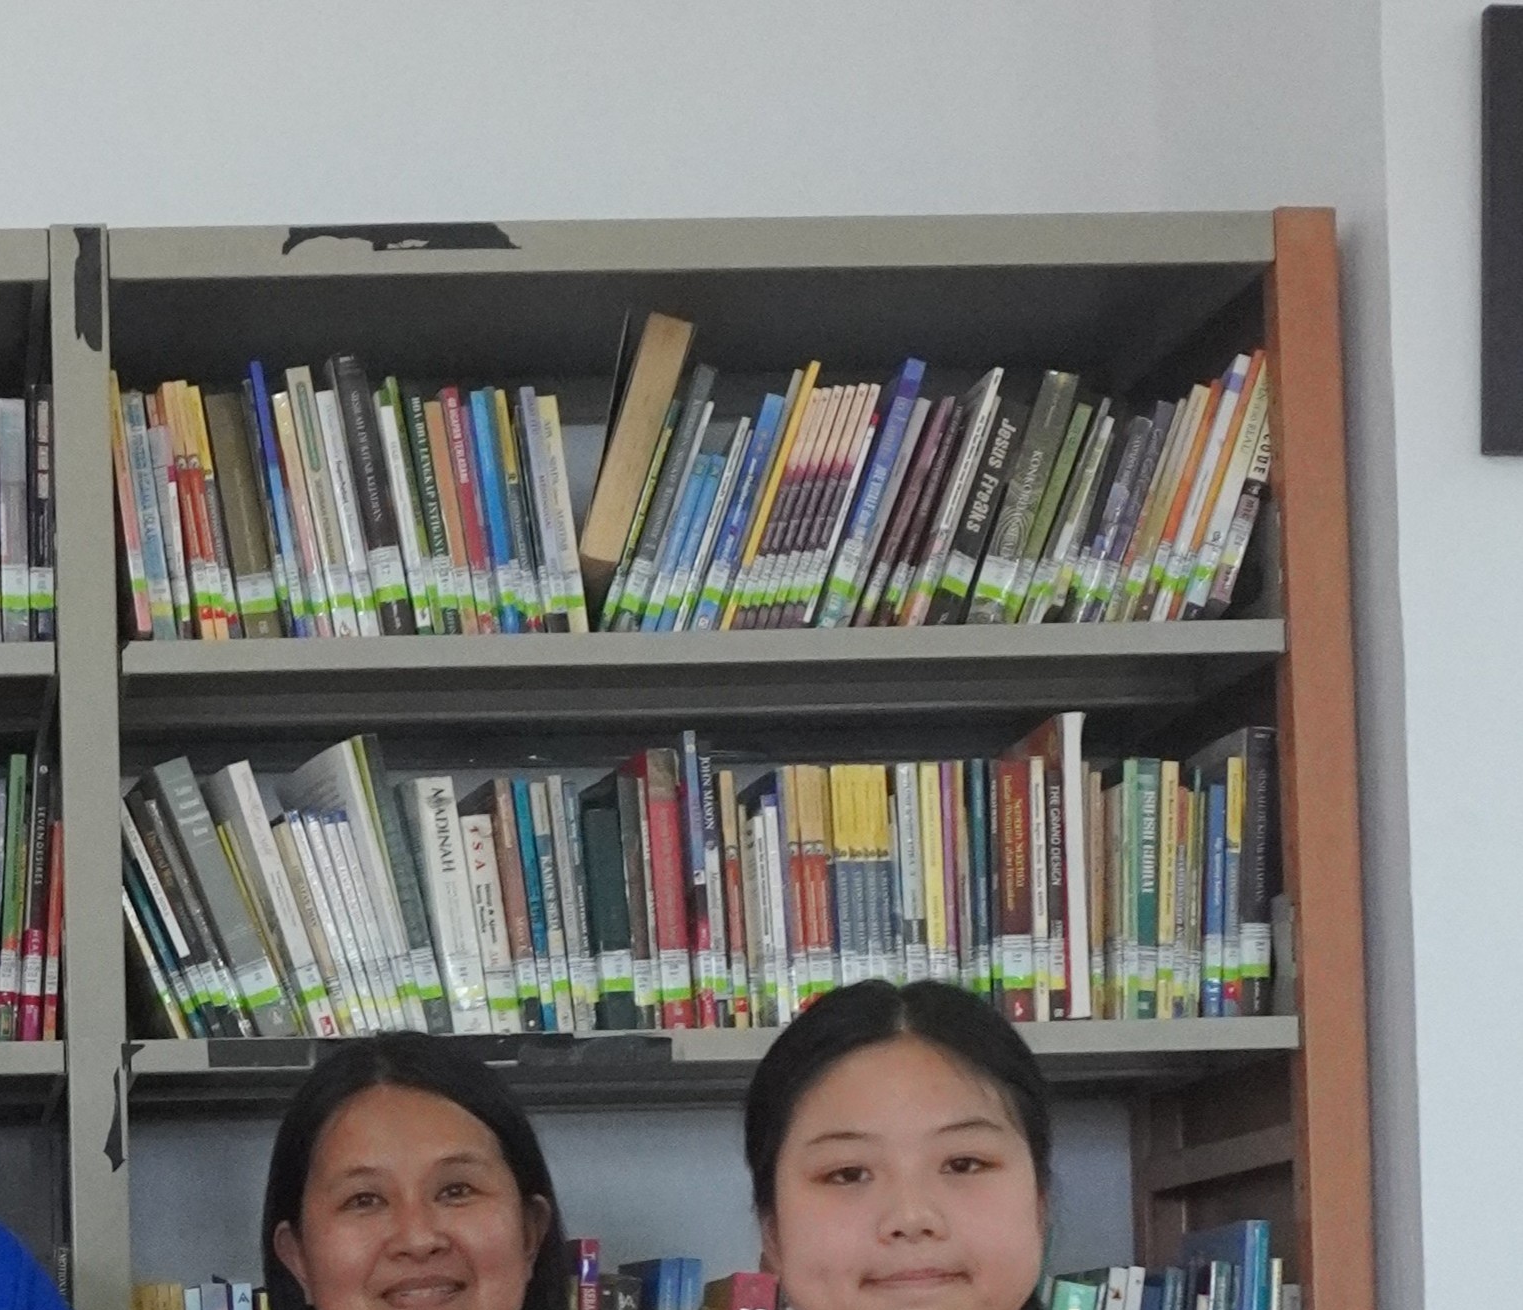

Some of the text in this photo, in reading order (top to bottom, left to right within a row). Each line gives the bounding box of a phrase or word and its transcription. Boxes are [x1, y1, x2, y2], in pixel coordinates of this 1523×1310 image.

[965, 418, 1016, 534] Jesus Freaks
[431, 788, 455, 874] MADINAH
[698, 756, 714, 830] JOHN MASON
[1050, 785, 1062, 886] THE GRAND DESIGN
